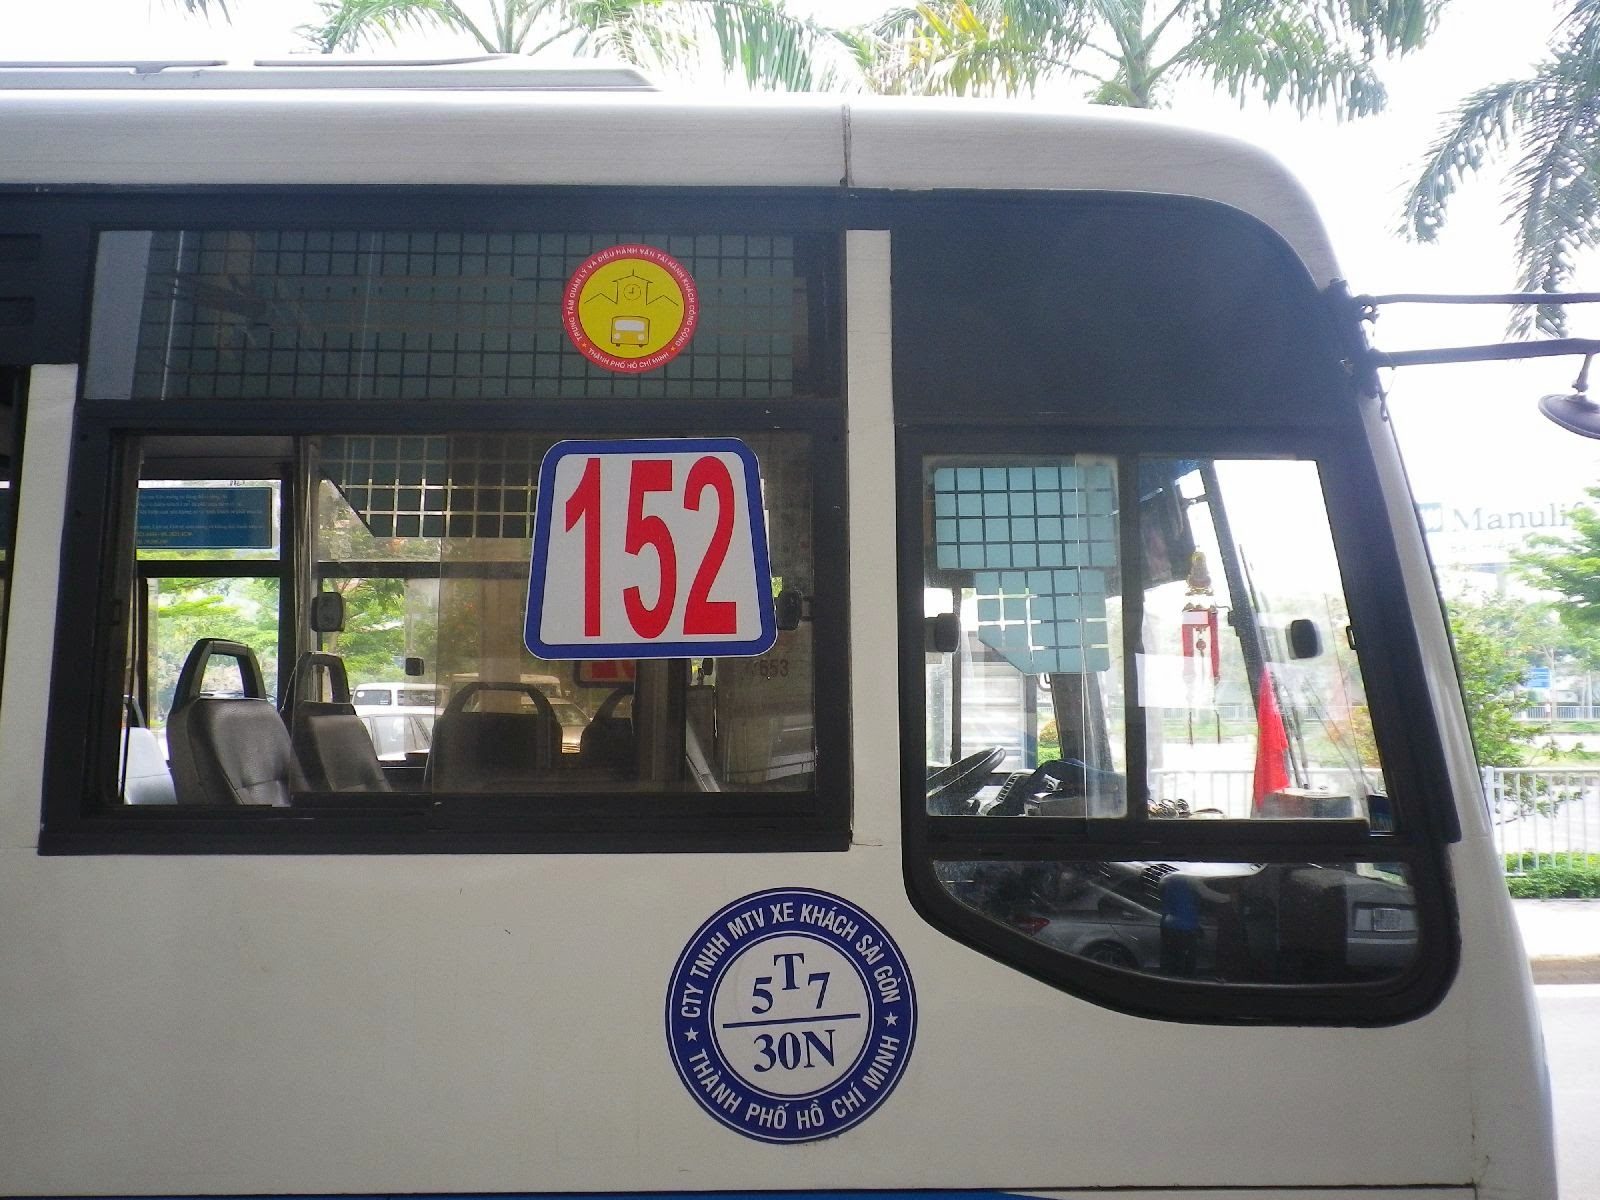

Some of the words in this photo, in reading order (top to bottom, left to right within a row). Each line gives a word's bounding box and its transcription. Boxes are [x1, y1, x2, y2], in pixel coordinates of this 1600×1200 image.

[568, 316, 583, 341] TRUNG
[580, 268, 588, 281] LÝ
[616, 247, 638, 256] HÀNH
[682, 278, 695, 303] KHÁCH
[639, 359, 652, 368] CHÍ
[652, 352, 670, 364] MINH
[565, 455, 738, 639] 152
[727, 907, 765, 940] MTV
[770, 902, 795, 924] XE
[800, 903, 860, 942] KHÁCH
[690, 931, 731, 979] TNHH
[855, 934, 884, 966] SÀI
[681, 982, 704, 1018] CTY
[873, 964, 900, 1004] GÒN
[753, 1029, 836, 1072] 30N
[688, 1048, 742, 1114] THÀNH
[745, 1101, 789, 1130] PHỐ
[797, 1100, 825, 1130] HỒ
[831, 1082, 867, 1119] CHÍ
[862, 1035, 900, 1091] MINH
